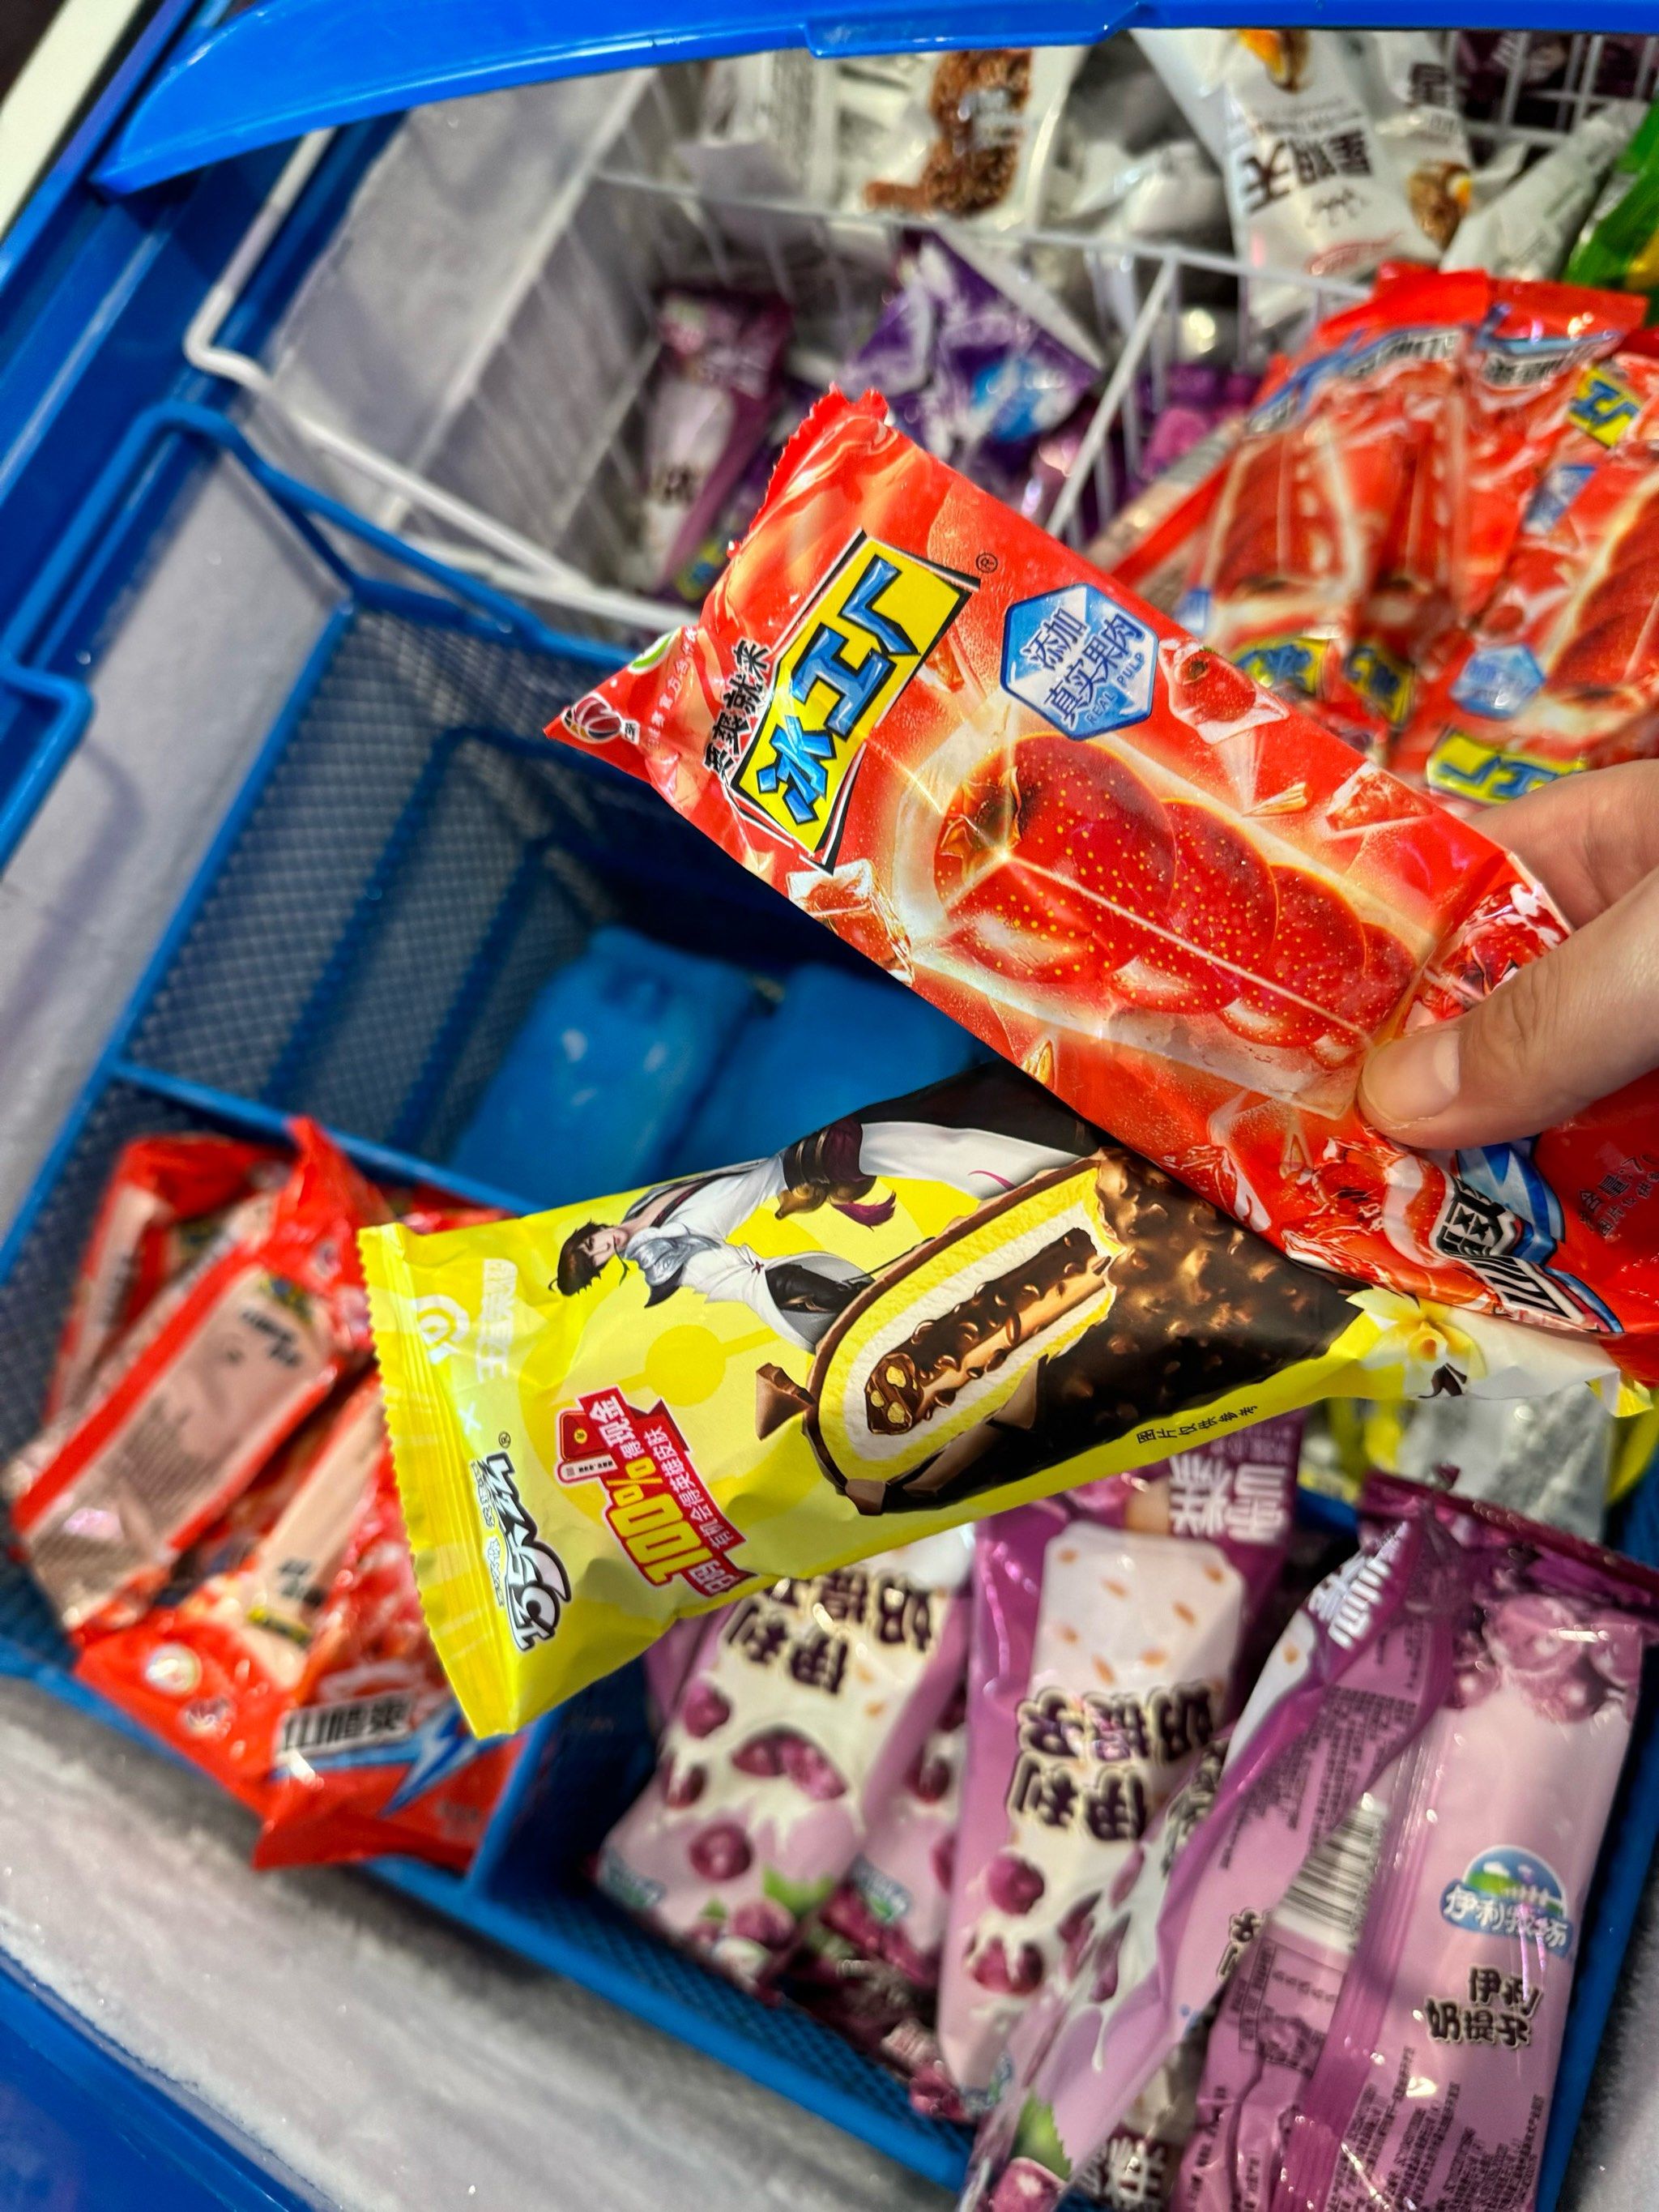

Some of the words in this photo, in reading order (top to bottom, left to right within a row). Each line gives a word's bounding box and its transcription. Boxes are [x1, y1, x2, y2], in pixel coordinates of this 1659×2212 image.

[1021, 606, 1088, 671] 添加
[1043, 613, 1145, 727] 真实果肉
[757, 549, 922, 825] 冰工厂
[1085, 690, 1117, 724] REAL
[1116, 651, 1145, 686] PULP
[476, 1258, 518, 1382] 王者荣耀
[1136, 1404, 1260, 1445] 图片仅供参考
[644, 1424, 734, 1548] 有机会得英雄皮肤
[486, 1451, 571, 1653] 巧乐兹
[1424, 1995, 1533, 2051] 奶提子
[1469, 1966, 1544, 2018] 伊利
